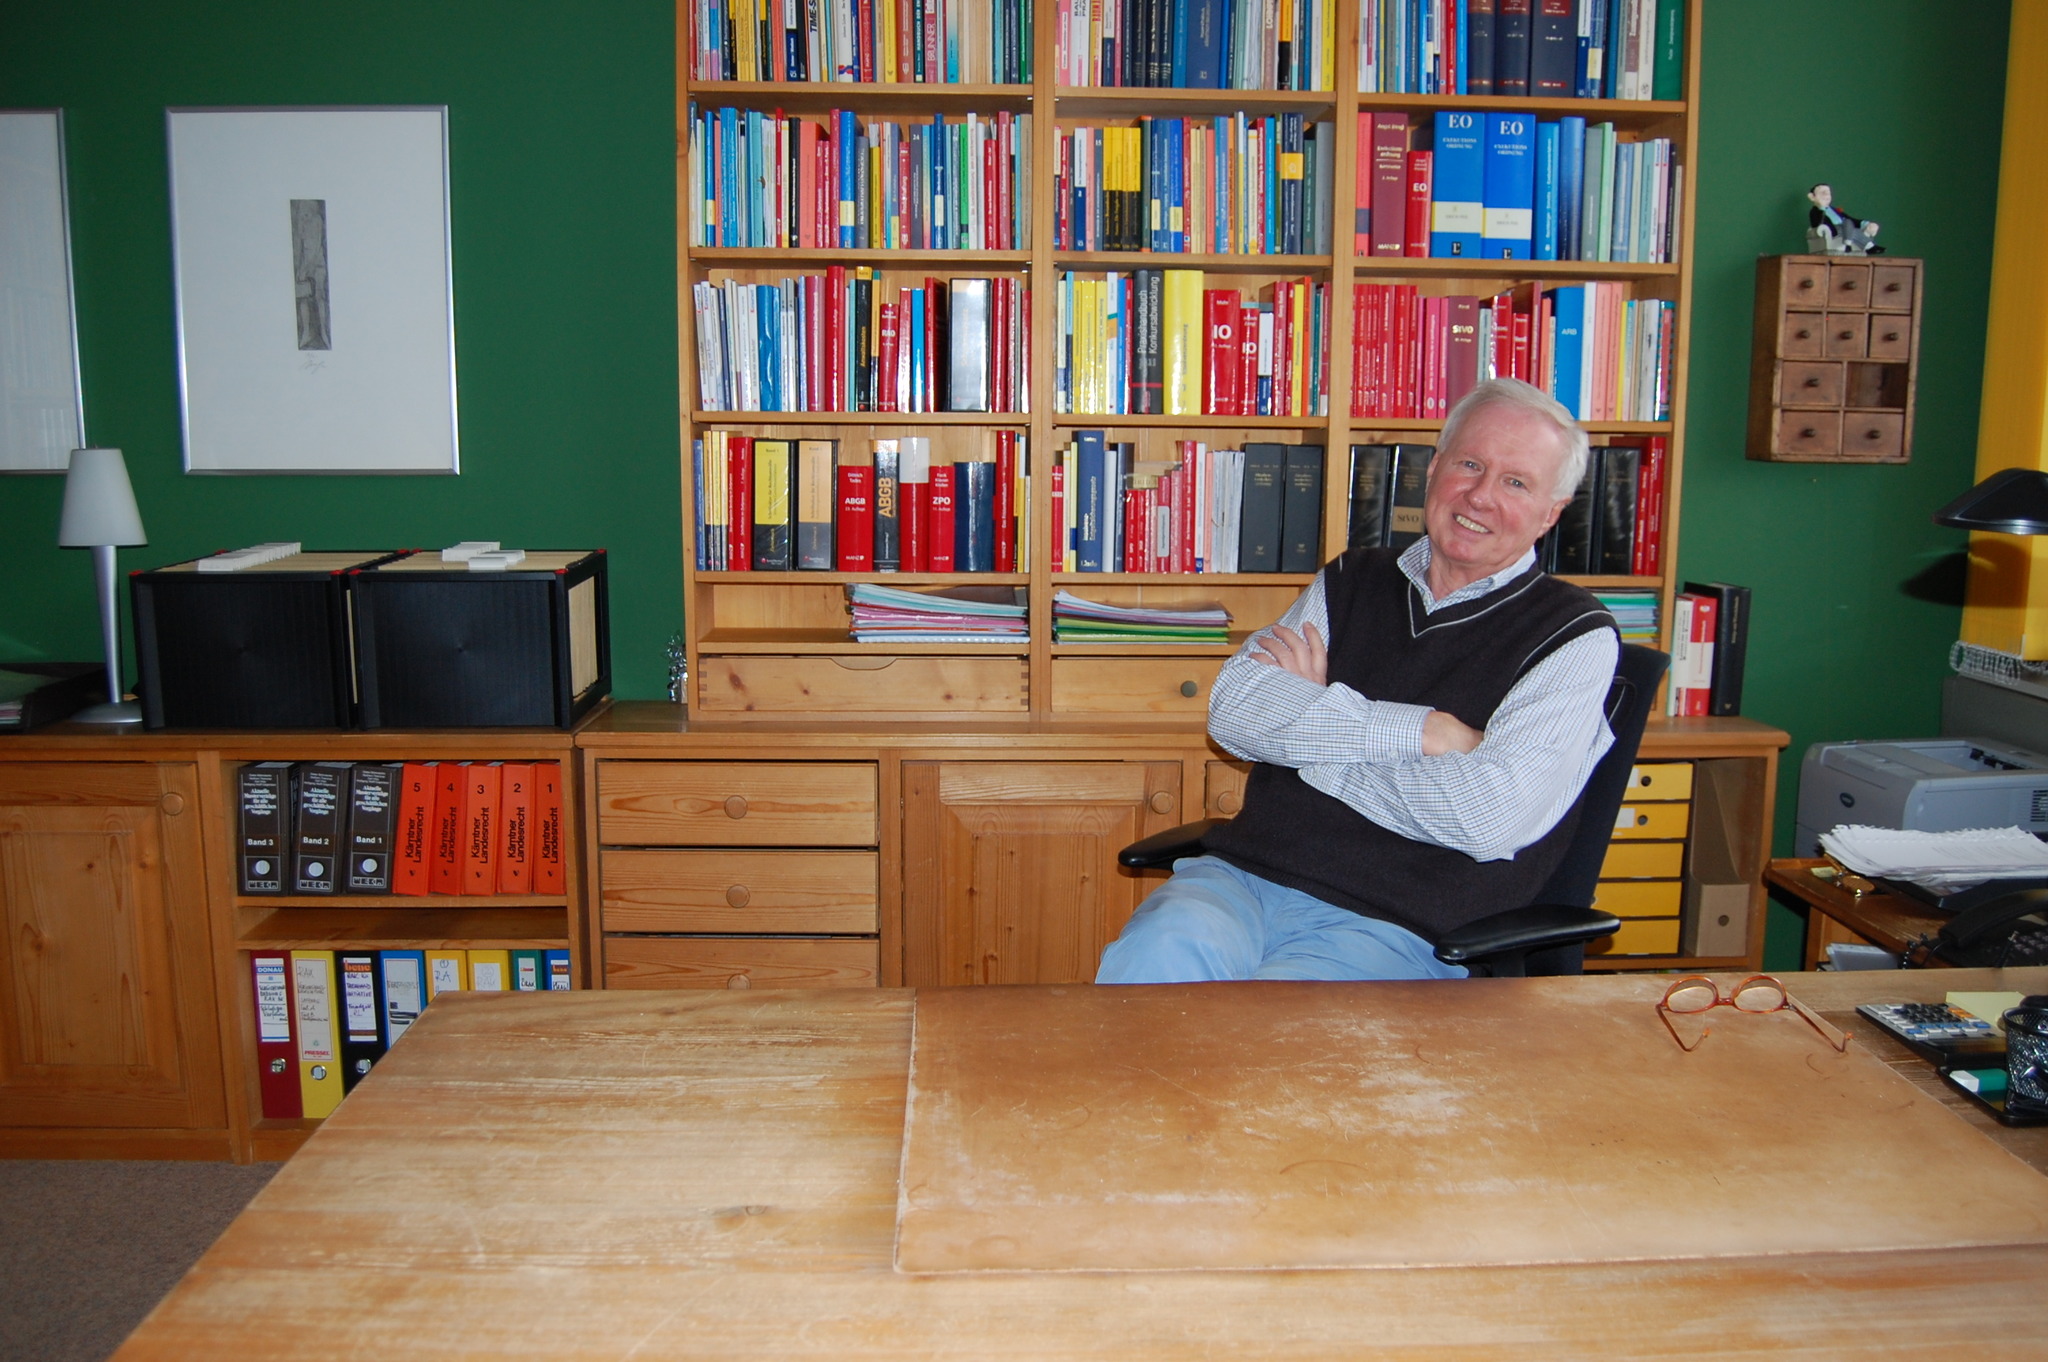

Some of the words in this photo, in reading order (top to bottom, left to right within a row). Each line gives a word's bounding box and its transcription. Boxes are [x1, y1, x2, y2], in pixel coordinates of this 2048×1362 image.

[927, 23, 935, 61] BRUNNER
[1448, 114, 1472, 128] EO
[1500, 121, 1523, 136] EO
[1413, 183, 1427, 192] EO
[1138, 290, 1148, 354] Praxishandbuch
[1149, 277, 1159, 354] Konkursabwicklung
[1213, 325, 1232, 340] IO
[1452, 325, 1474, 334] StVO
[1242, 342, 1257, 354] IO
[878, 477, 892, 517] ABGB
[932, 497, 950, 505] ZPO
[414, 783, 420, 792] 5
[447, 783, 454, 792] 4
[477, 785, 485, 794] 3
[513, 783, 521, 792] 2
[547, 783, 552, 792] 1
[405, 818, 415, 857] Kärntner
[413, 806, 424, 862] Landesrecht
[440, 818, 449, 857] Kärntner
[447, 806, 457, 863] Landesrecht
[471, 818, 480, 857] Kärntner
[480, 807, 489, 863] Landesrecht
[507, 819, 516, 858] Kärntner
[516, 807, 525, 862] Landesrecht
[345, 960, 371, 971] bene
